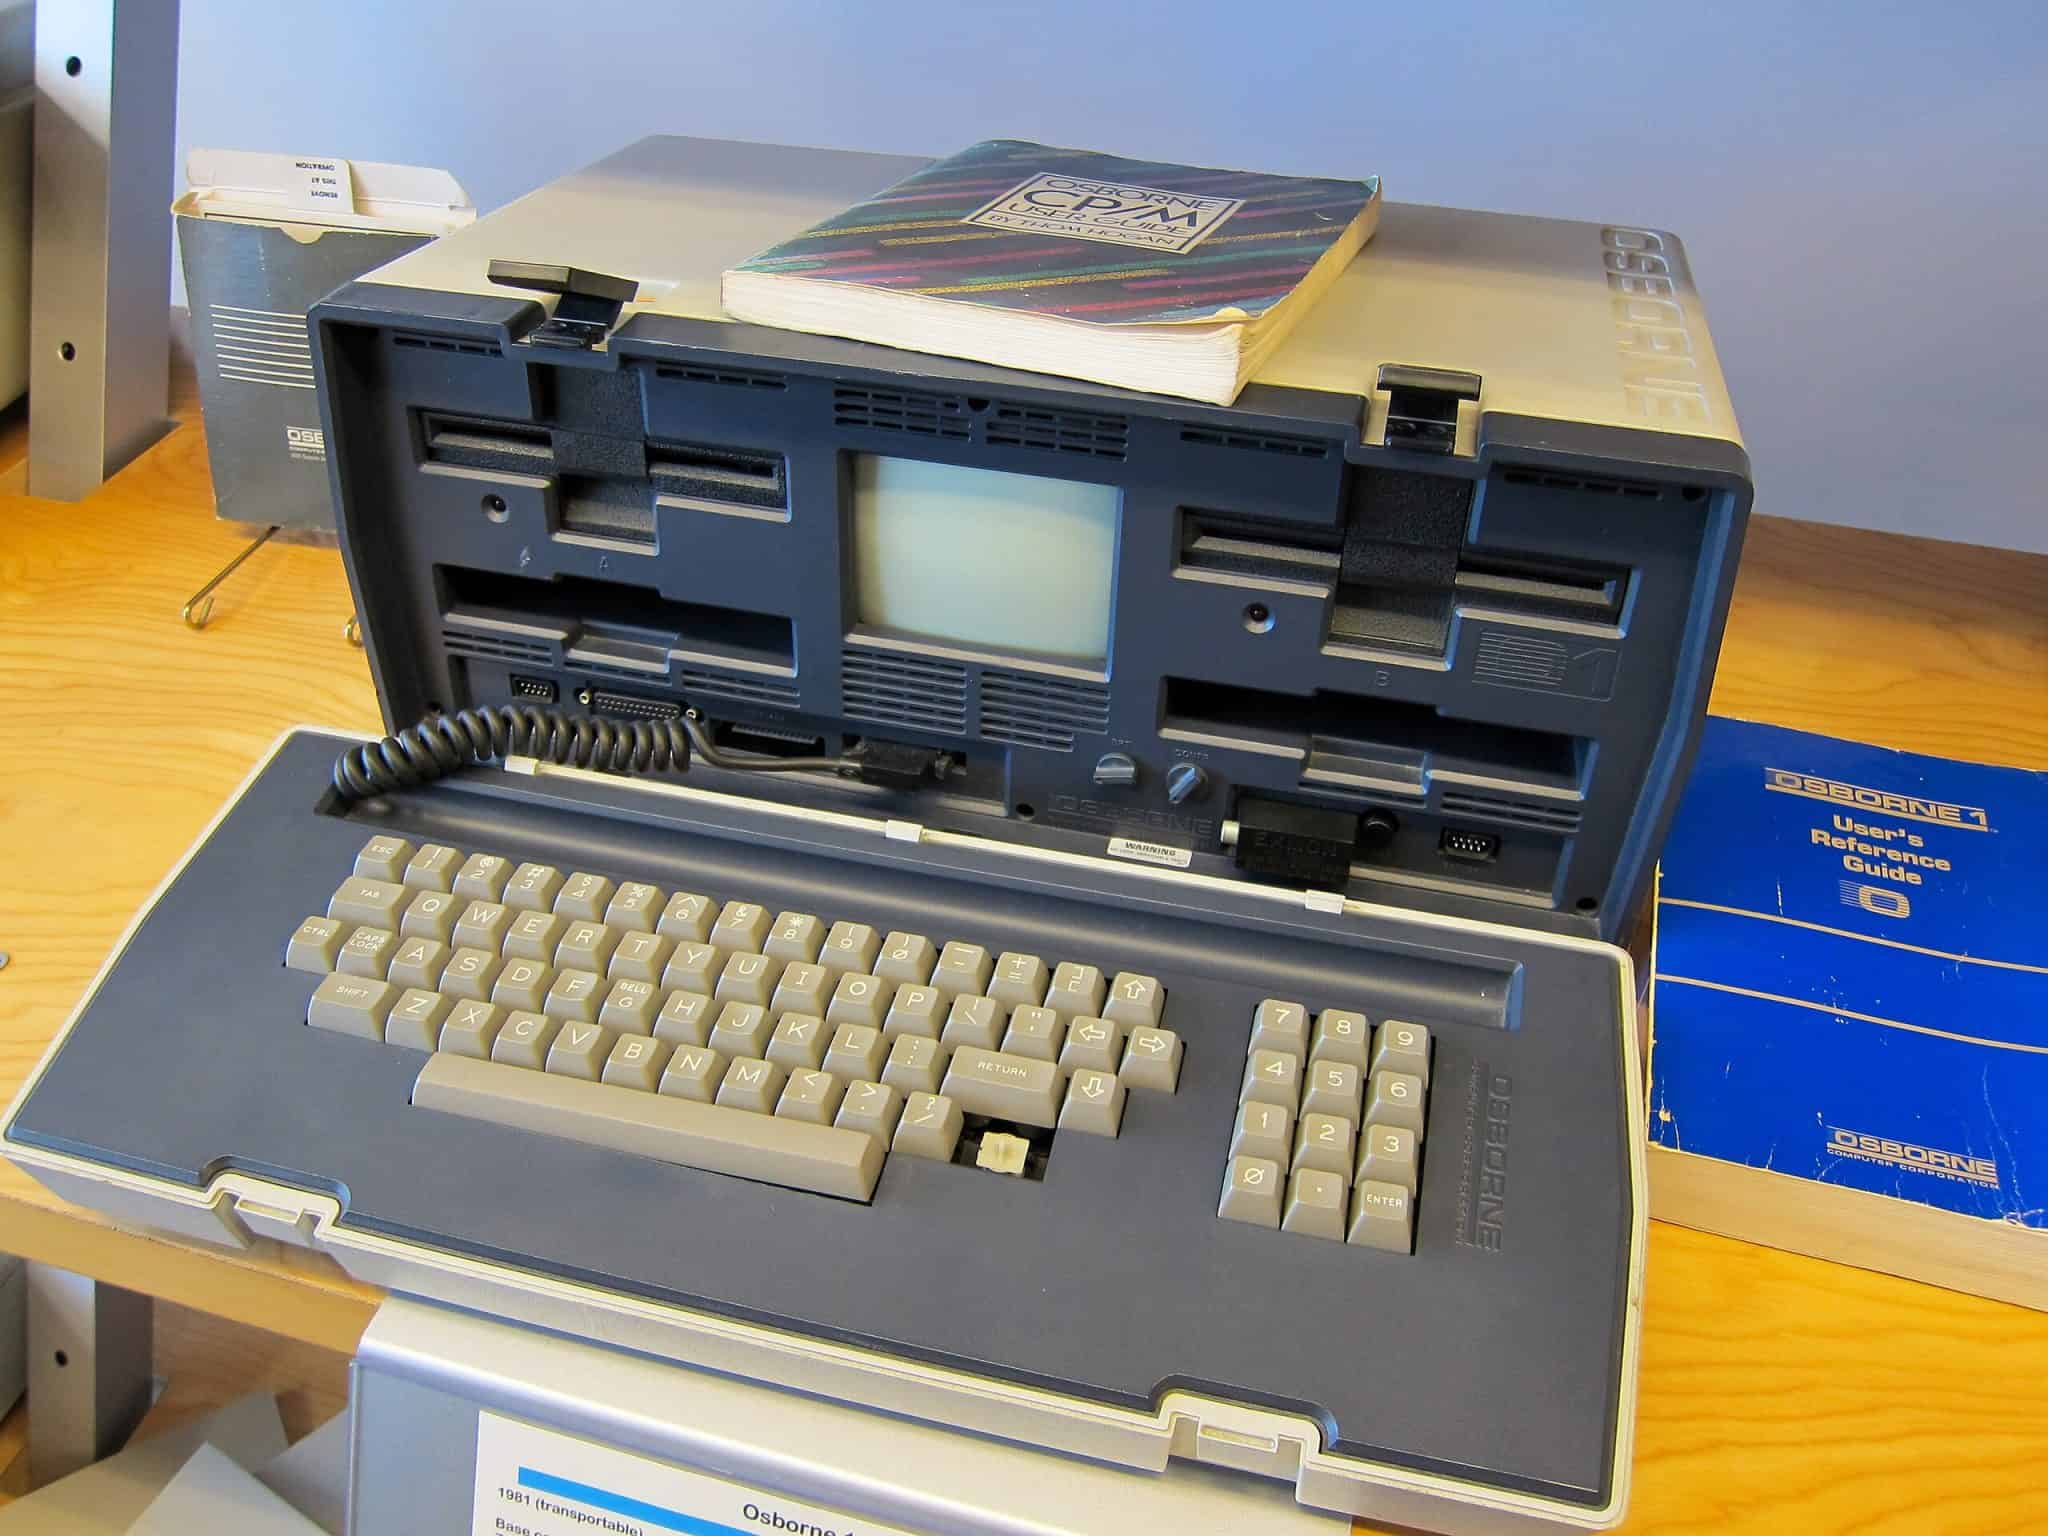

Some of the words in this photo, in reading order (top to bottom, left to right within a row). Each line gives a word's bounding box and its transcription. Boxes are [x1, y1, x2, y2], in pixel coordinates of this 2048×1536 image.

[1046, 179, 1220, 214] OSBORNE
[1023, 190, 1198, 228] CP/M
[1008, 202, 1087, 222] USER
[1094, 216, 1194, 236] GUIDE
[1774, 772, 1962, 822] OSBORNE
[1968, 810, 1988, 826] 1
[1833, 814, 1925, 848] User's
[1126, 842, 1177, 856] WARNING
[1810, 828, 1952, 872] Reference
[1842, 855, 1923, 886] Guide
[472, 907, 497, 923] W
[675, 909, 689, 920] 6
[303, 925, 330, 937] CTRL
[523, 918, 543, 933] E
[356, 932, 384, 944] CAPS
[575, 929, 594, 945] R
[783, 929, 798, 939] 8
[350, 939, 379, 951] LOCK
[633, 939, 649, 953] T
[840, 938, 854, 949] 9
[407, 945, 425, 961] A
[687, 949, 703, 964] Y
[459, 957, 480, 972] S
[738, 959, 758, 975] U
[1011, 957, 1027, 969] +
[511, 966, 532, 982] D
[796, 971, 809, 985] I
[336, 984, 369, 998] SHIFT
[566, 979, 586, 993] F
[849, 981, 867, 996] O
[405, 997, 428, 1014] Z
[618, 996, 633, 1008] G
[674, 999, 696, 1016] H
[906, 992, 925, 1007] P
[460, 1007, 482, 1025] X
[732, 1014, 750, 1028] J
[1275, 1008, 1291, 1024] 7
[515, 1020, 535, 1036] C
[787, 1021, 809, 1038] K
[1335, 1019, 1352, 1035] 8
[572, 1027, 591, 1045] V
[845, 1032, 860, 1049] L
[1397, 1031, 1414, 1047] 9
[623, 1043, 643, 1060] B
[680, 1054, 703, 1072] N
[977, 1061, 1027, 1078] RETURN
[1264, 1061, 1285, 1077] 4
[735, 1065, 762, 1084] M
[1329, 1071, 1344, 1087] 5
[1390, 1081, 1408, 1098] 6
[1318, 1123, 1336, 1142] 2
[1383, 1135, 1401, 1152] 3
[1834, 1129, 1997, 1178] OSBORNE
[1826, 1148, 1894, 1168] COMPUTER
[1899, 1163, 2001, 1191] CORPORATION
[1365, 1193, 1403, 1208] ENTER
[497, 1486, 531, 1506] 1981
[535, 1497, 644, 1536] (transportable)
[495, 1517, 531, 1536] Base
